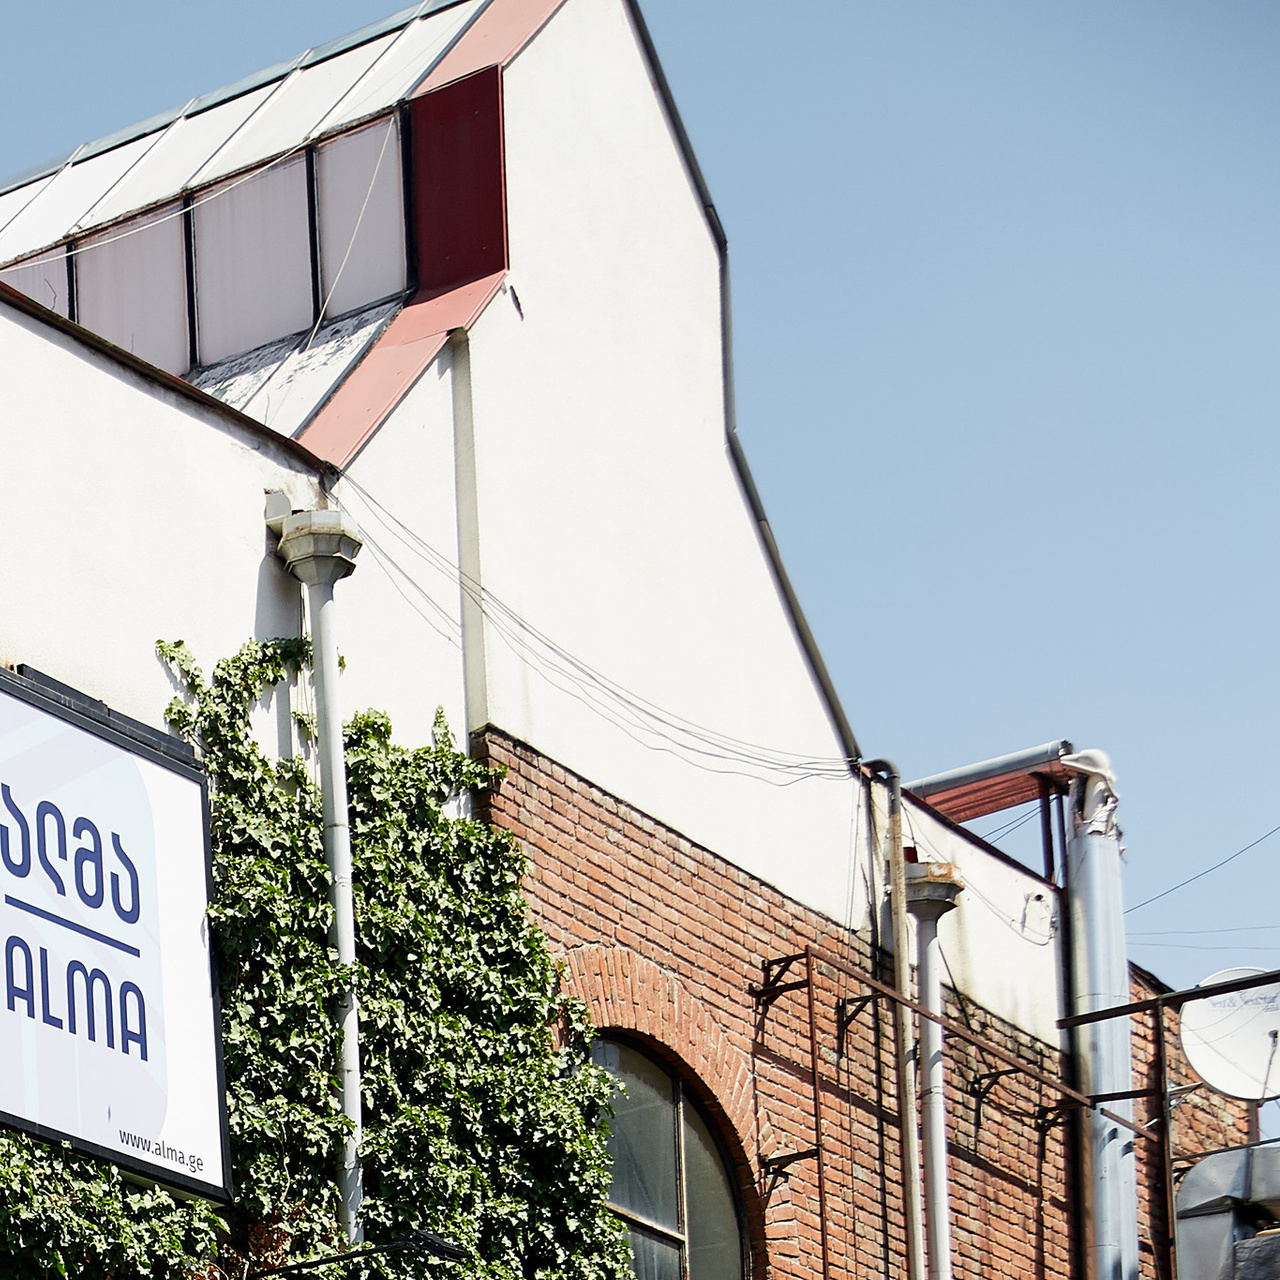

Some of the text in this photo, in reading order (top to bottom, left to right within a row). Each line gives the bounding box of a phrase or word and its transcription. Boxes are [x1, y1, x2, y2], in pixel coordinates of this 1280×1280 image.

[0, 782, 140, 924] ალმა
[5, 935, 148, 1062] ALMA
[119, 1129, 204, 1173] www.alma.ge
